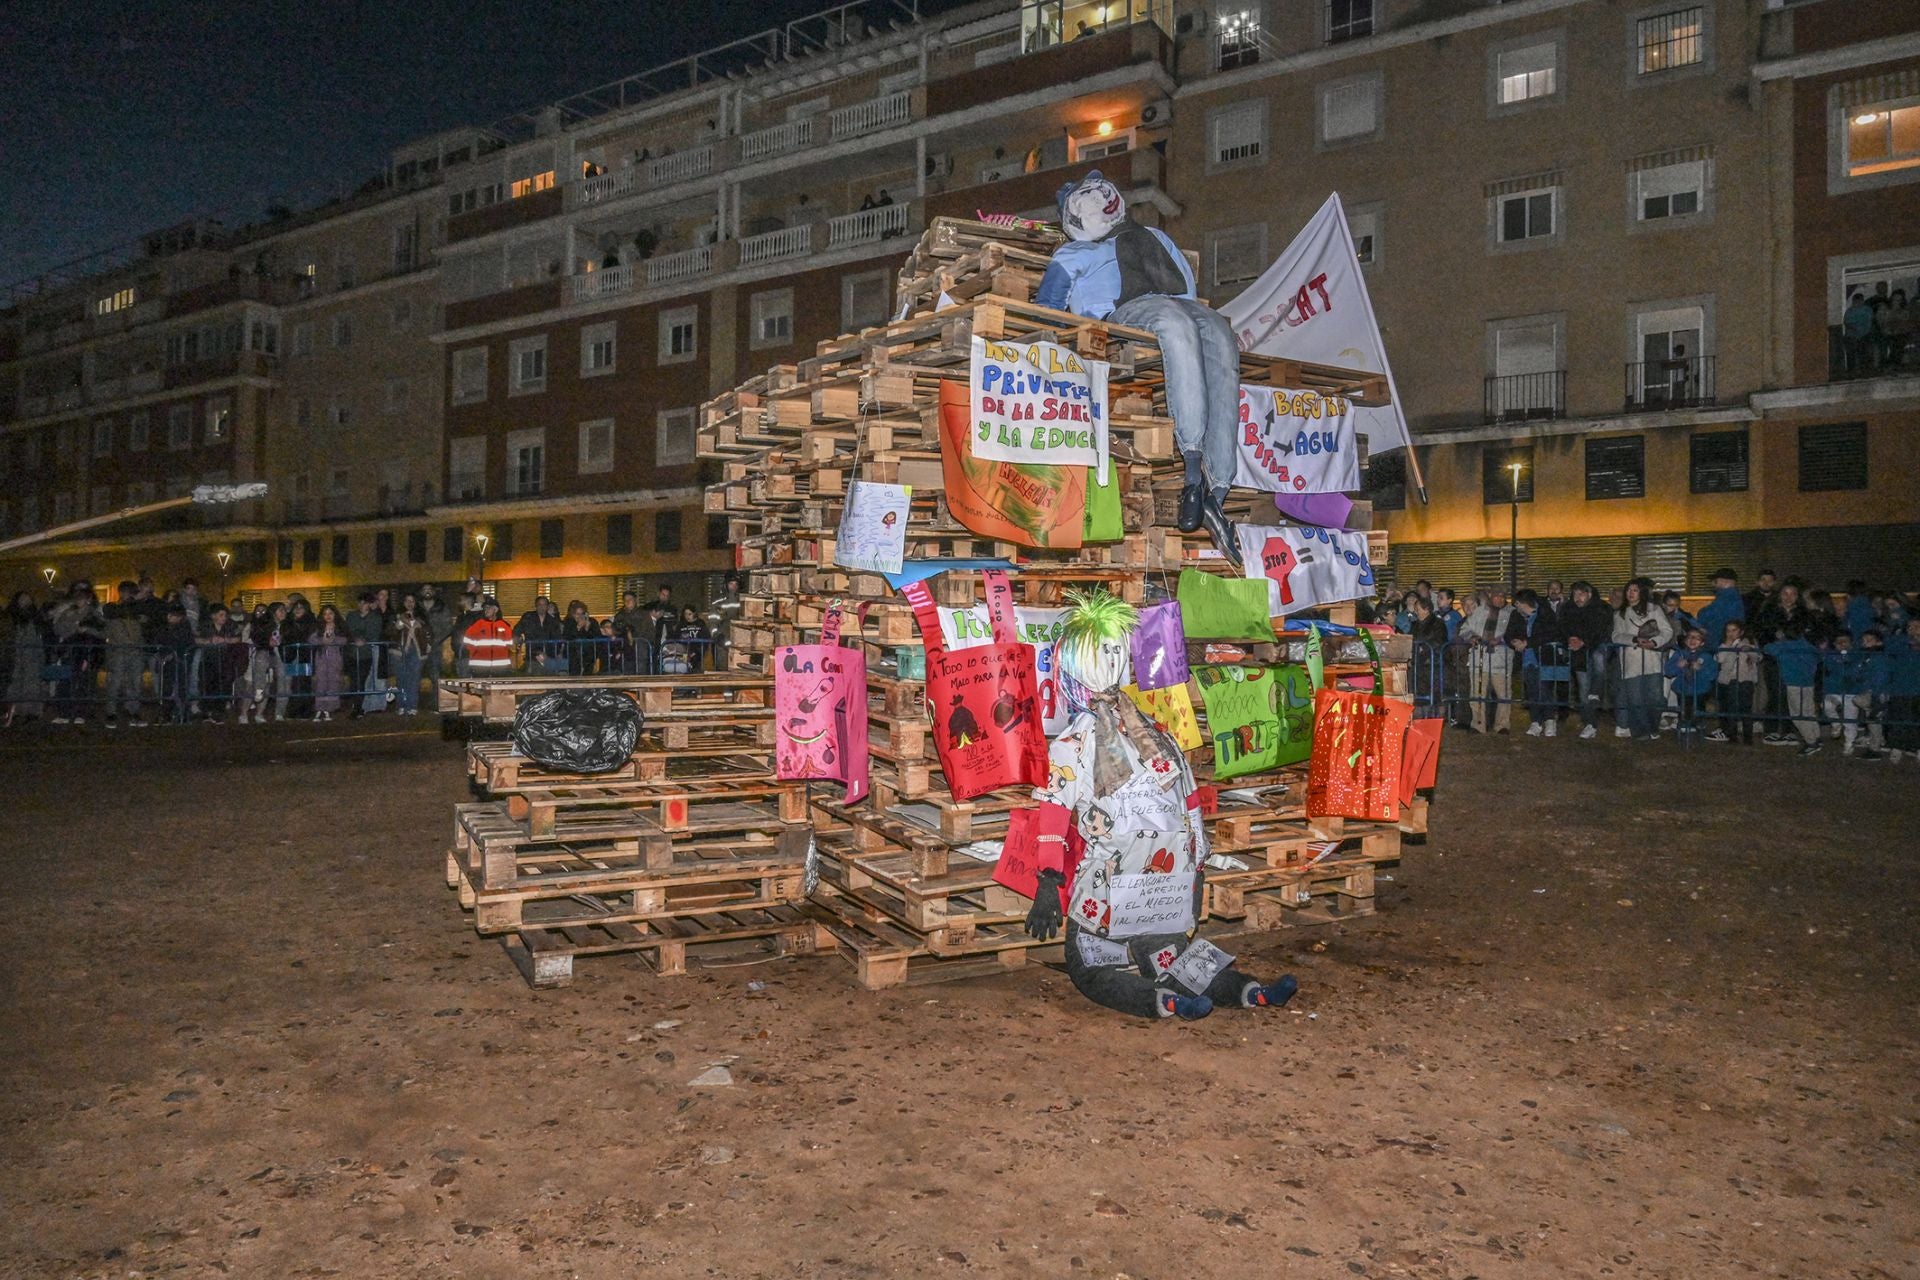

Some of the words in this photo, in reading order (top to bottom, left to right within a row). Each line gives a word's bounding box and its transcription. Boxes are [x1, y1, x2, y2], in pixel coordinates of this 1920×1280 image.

[985, 340, 1018, 363] NO
[1050, 347, 1085, 374] LA
[982, 397, 1005, 416] DE
[1012, 402, 1034, 421] LA
[1273, 391, 1347, 420] BASURA
[978, 421, 991, 442] Y
[997, 424, 1022, 448] LA
[1265, 552, 1288, 570] STOP
[937, 658, 963, 676] TODO
[967, 659, 976, 668] LO
[981, 654, 1003, 665] QUE
[951, 677, 970, 691] MALO
[973, 672, 993, 684] PARA
[999, 669, 1010, 678] LA
[1111, 877, 1126, 888] EL
[1140, 884, 1189, 897] AGRESIVO
[1125, 901, 1141, 910] EL
[1145, 896, 1183, 909] MIEDO
